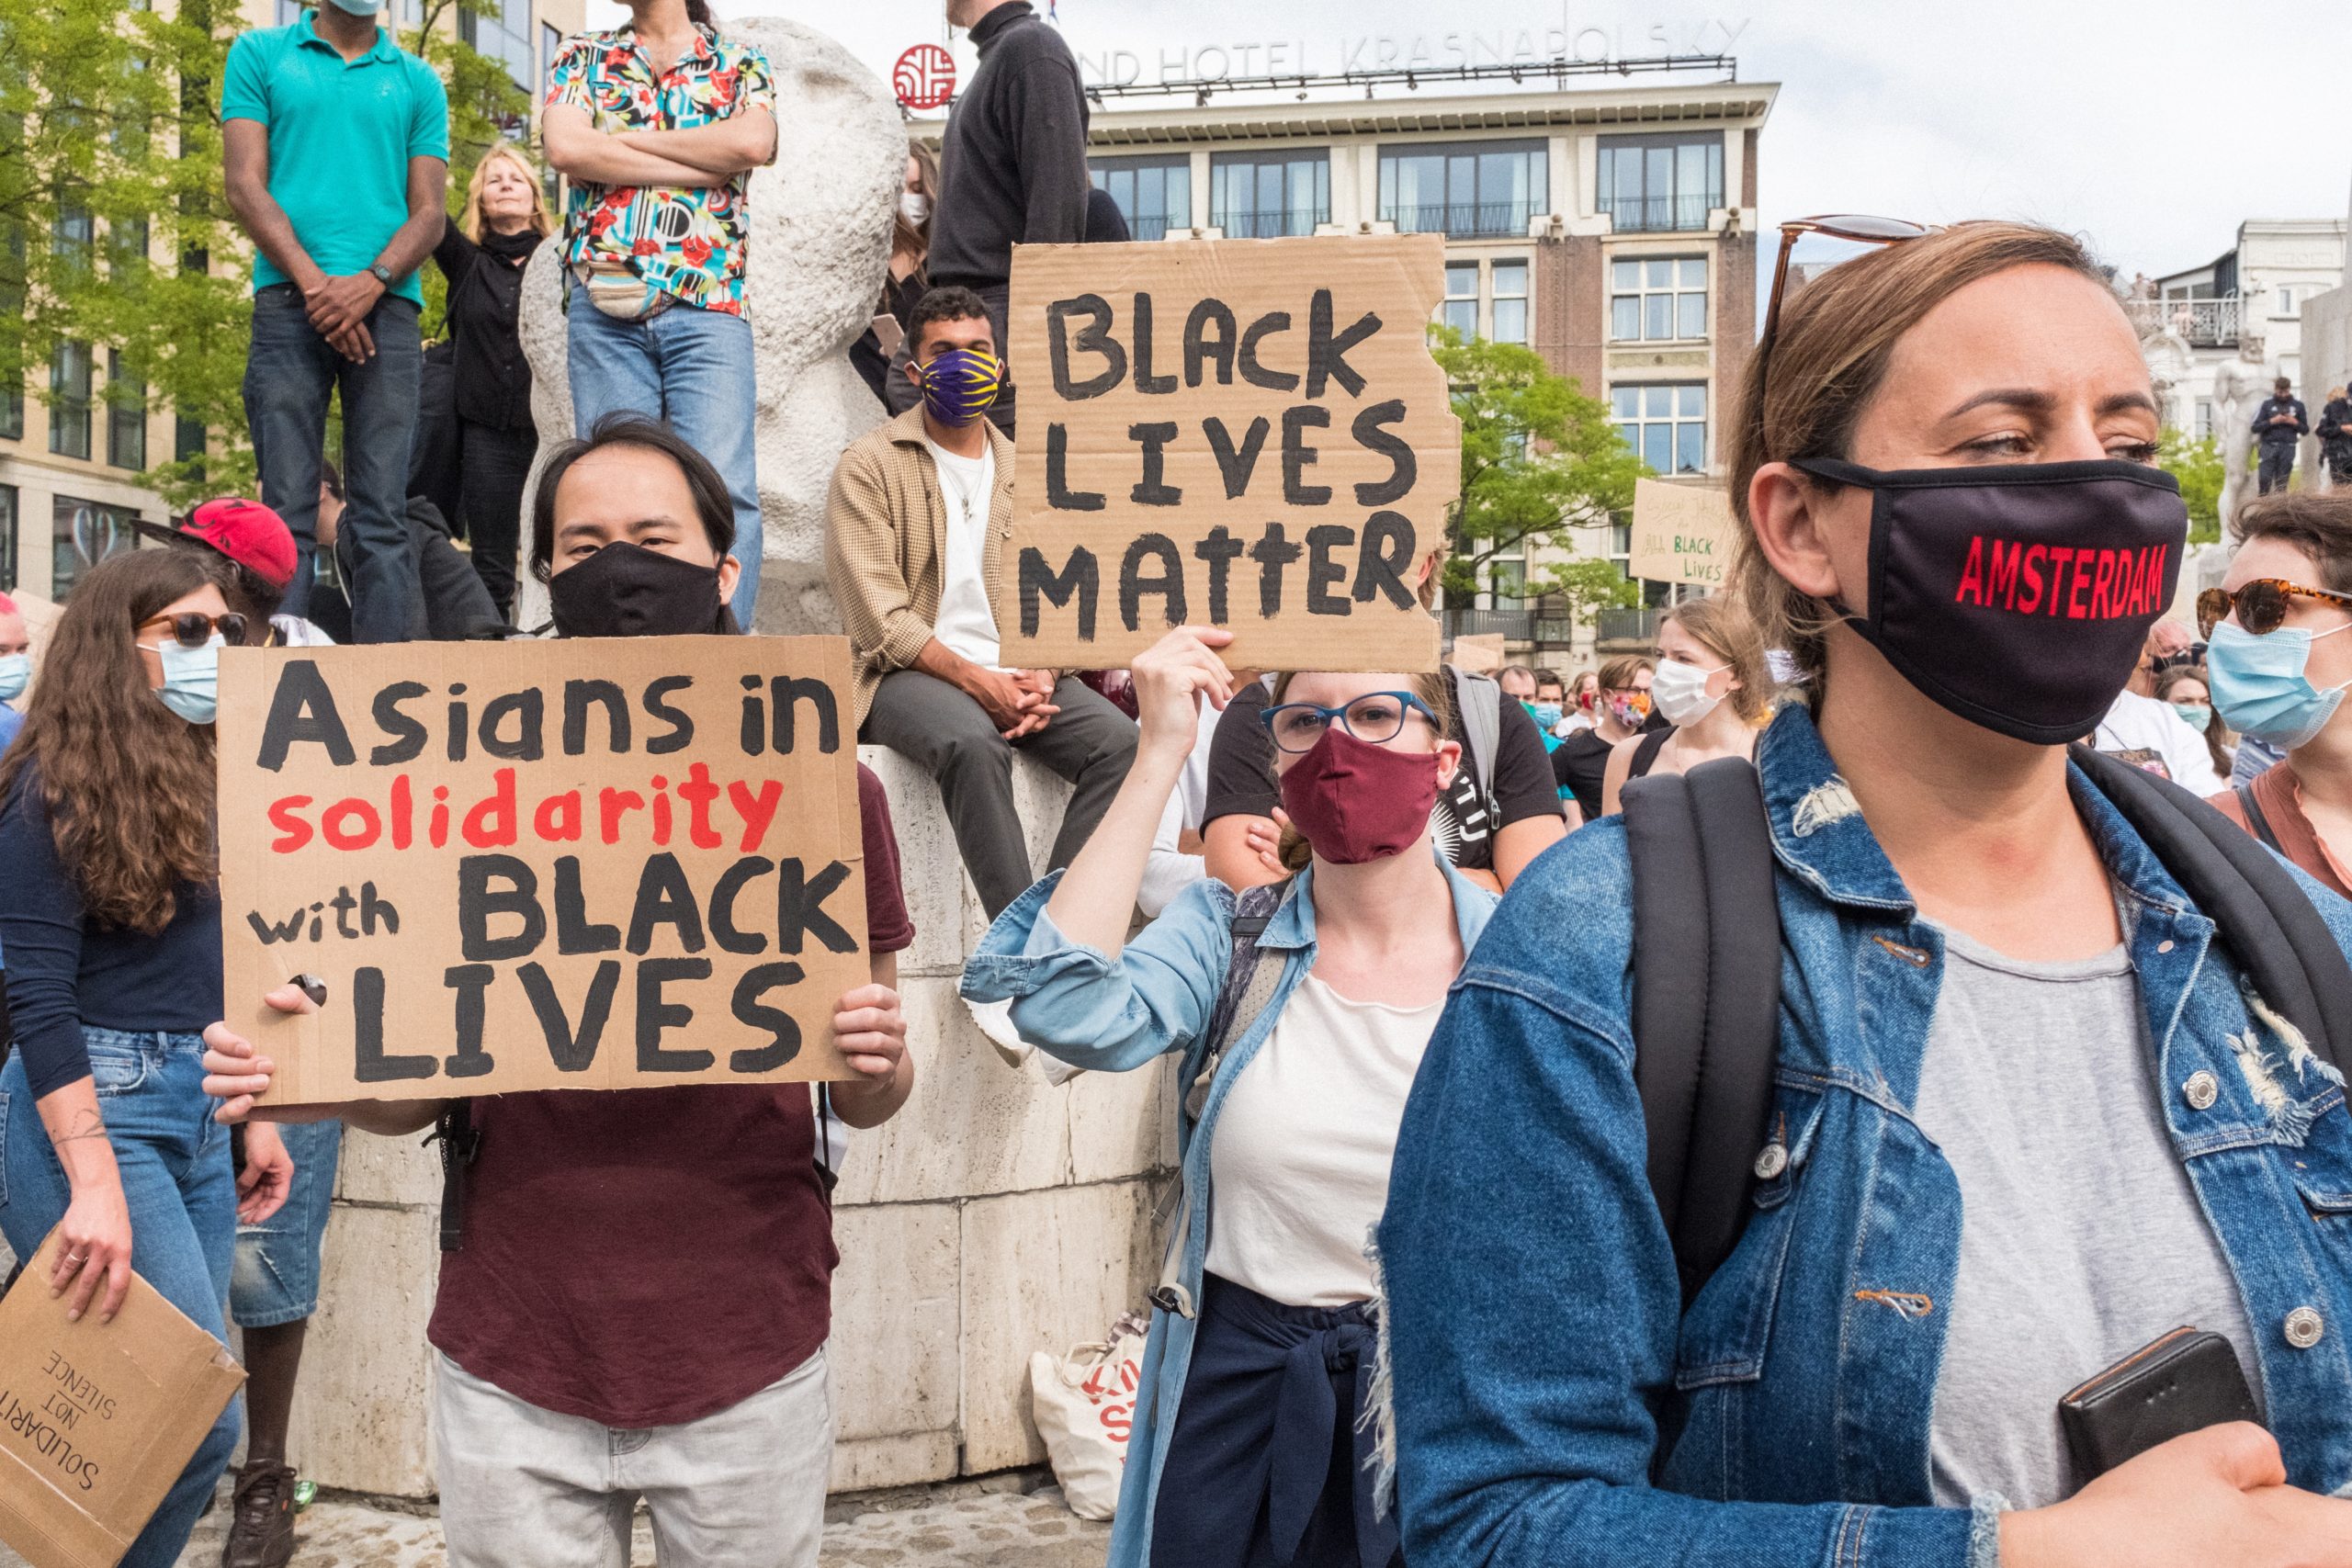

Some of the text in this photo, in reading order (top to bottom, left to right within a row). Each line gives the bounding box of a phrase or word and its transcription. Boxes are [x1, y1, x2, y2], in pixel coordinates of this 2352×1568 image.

[1160, 41, 1319, 81] HOTEL
[1341, 17, 1750, 73] KRASNAPOLSKY
[1046, 288, 1383, 400] BLACK
[1046, 400, 1417, 511] LIVES
[1674, 536, 1713, 555] BLACK
[1955, 536, 2166, 619] AMSTERDAM
[256, 660, 840, 773] Asians in
[267, 761, 784, 852] solidarity
[246, 852, 858, 962] with BLACK
[354, 958, 806, 1082] LIVES
[40, 1393, 80, 1430] NOT
[41, 1349, 117, 1420] SILENCE
